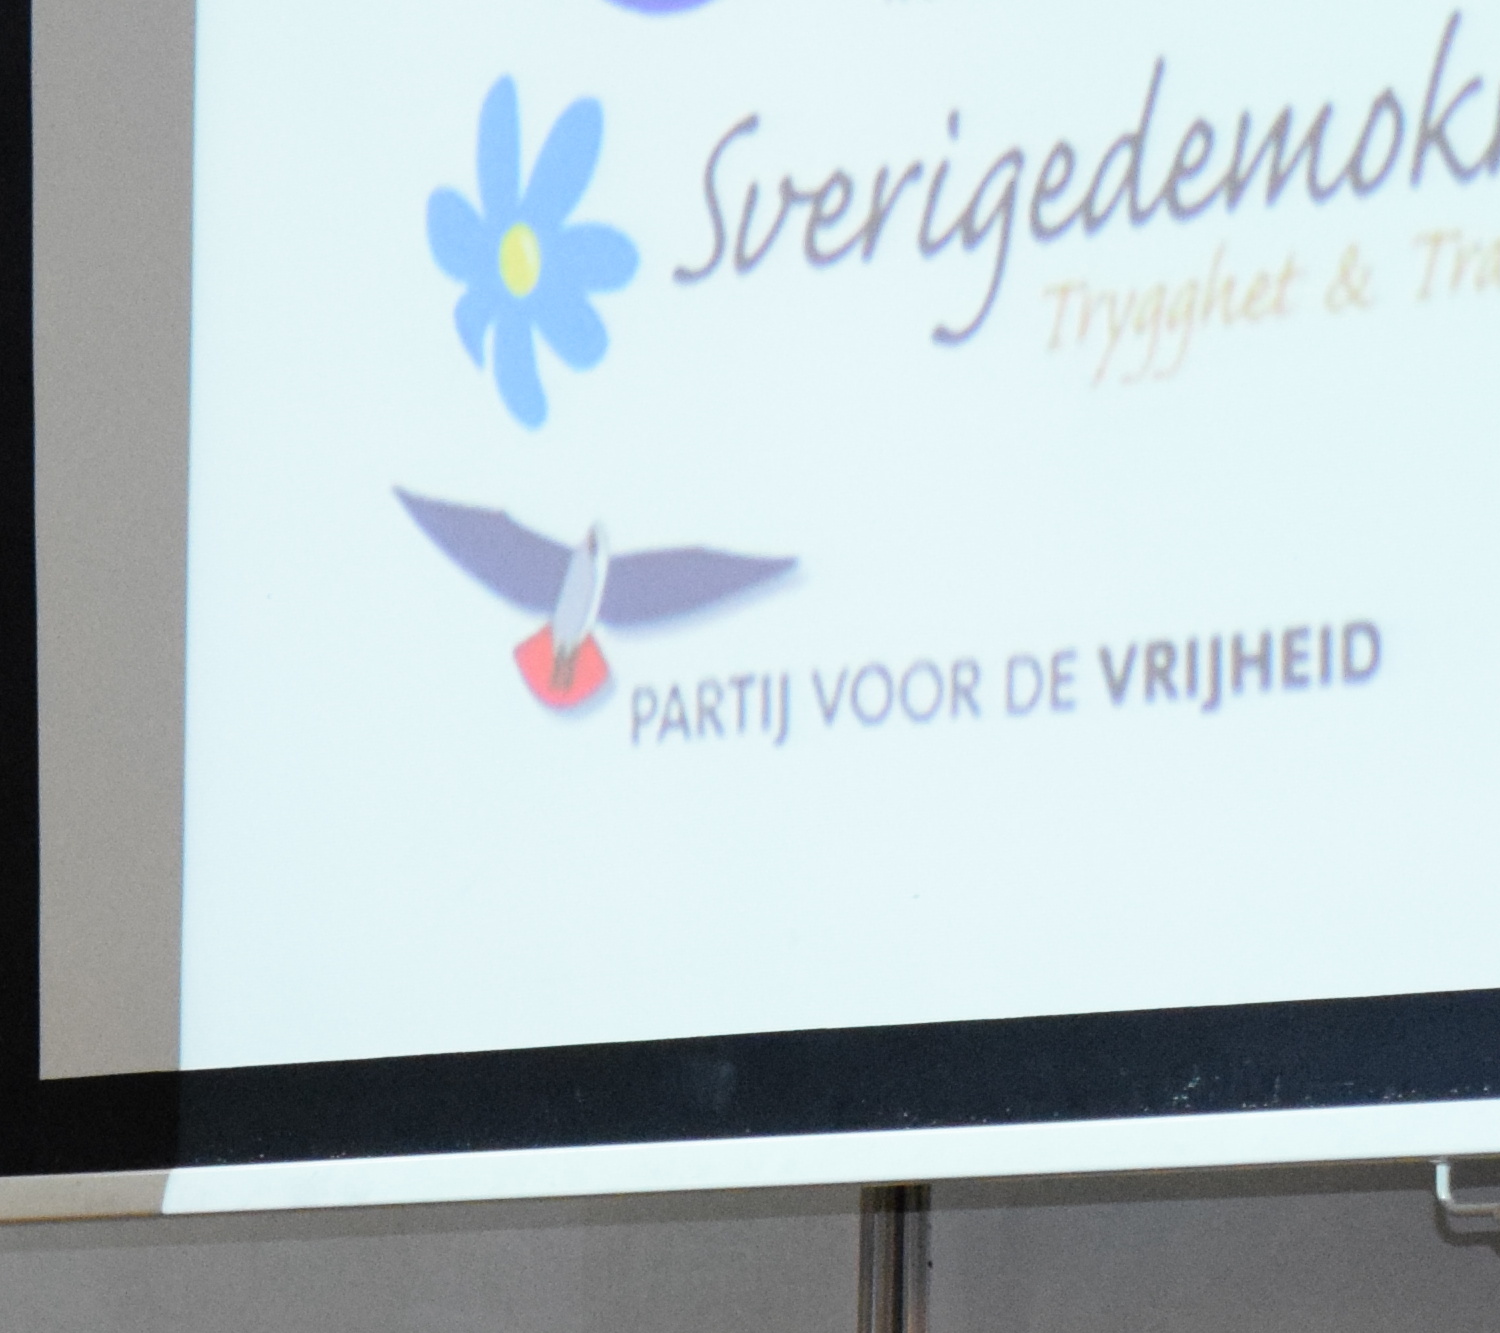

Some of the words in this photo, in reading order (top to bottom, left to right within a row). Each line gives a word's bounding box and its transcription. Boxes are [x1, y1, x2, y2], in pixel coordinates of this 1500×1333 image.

[1043, 240, 1303, 388] Trygghet
[1323, 244, 1374, 312] &
[630, 670, 790, 747] PARTIJ
[812, 658, 981, 727] VOOR
[1004, 650, 1078, 717] DE
[1095, 621, 1385, 712] VRIJHEID
